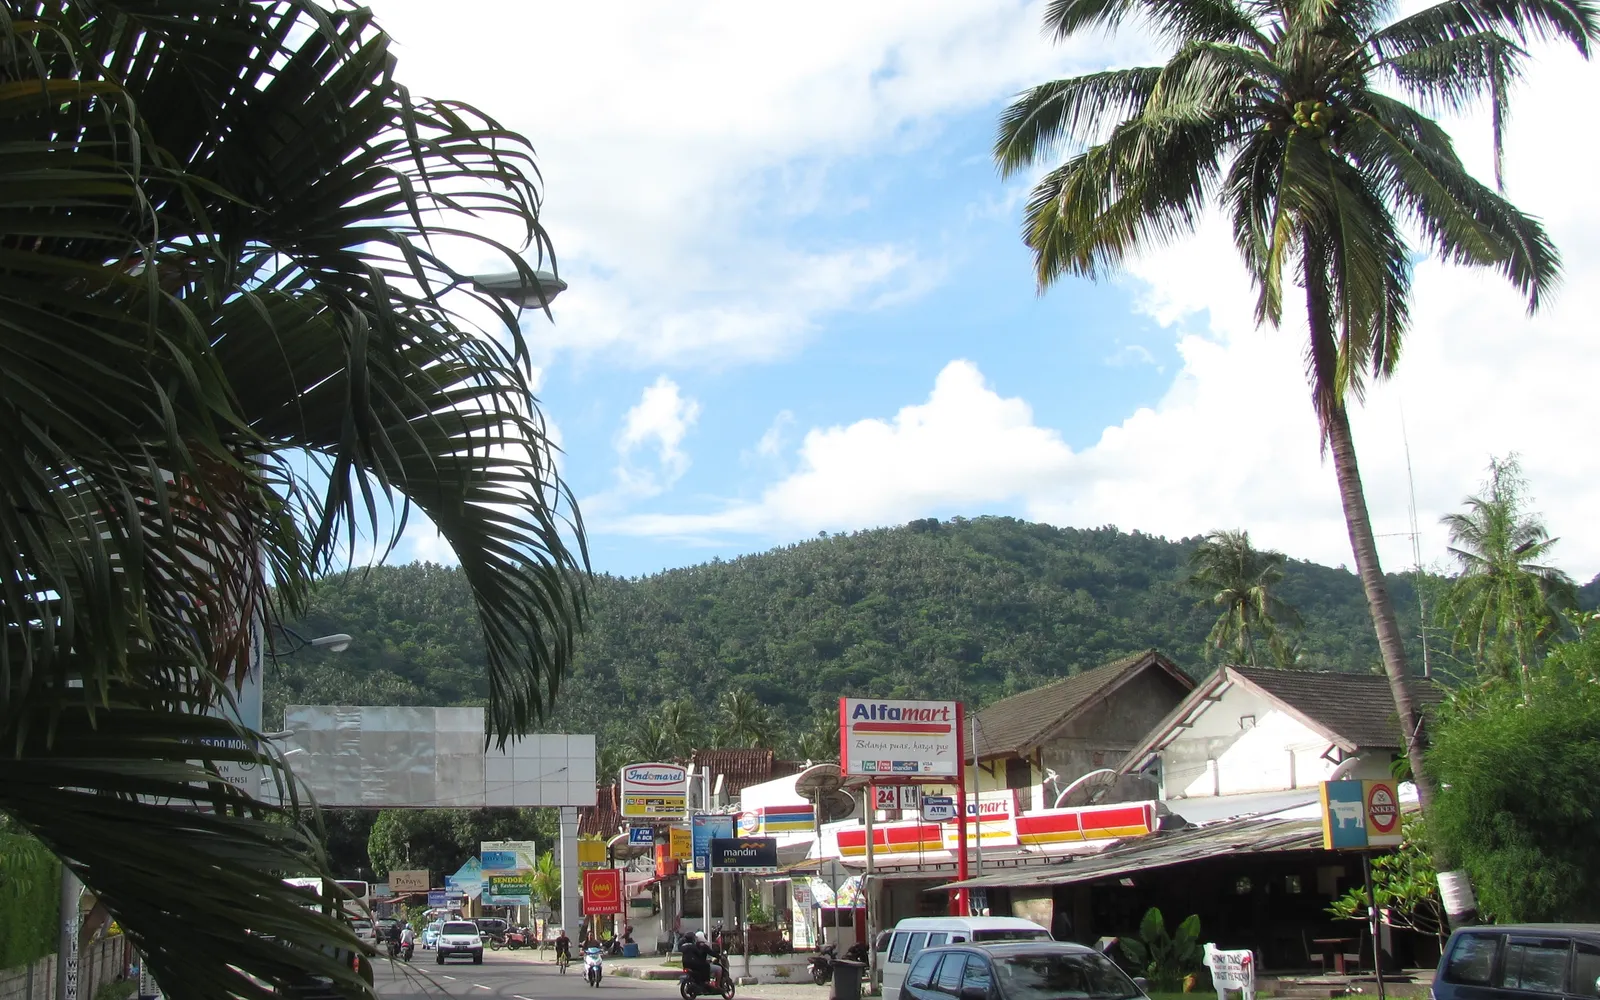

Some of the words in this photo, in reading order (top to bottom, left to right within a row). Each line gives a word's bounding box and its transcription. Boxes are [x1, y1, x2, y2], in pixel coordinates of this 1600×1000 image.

[852, 703, 950, 721] Alfamart
[855, 739, 888, 751] Belanja
[913, 741, 934, 753] harga
[627, 769, 682, 781] Indomaret
[878, 790, 895, 803] 24
[1370, 805, 1396, 813] ANKER
[723, 848, 757, 856] mandiri
